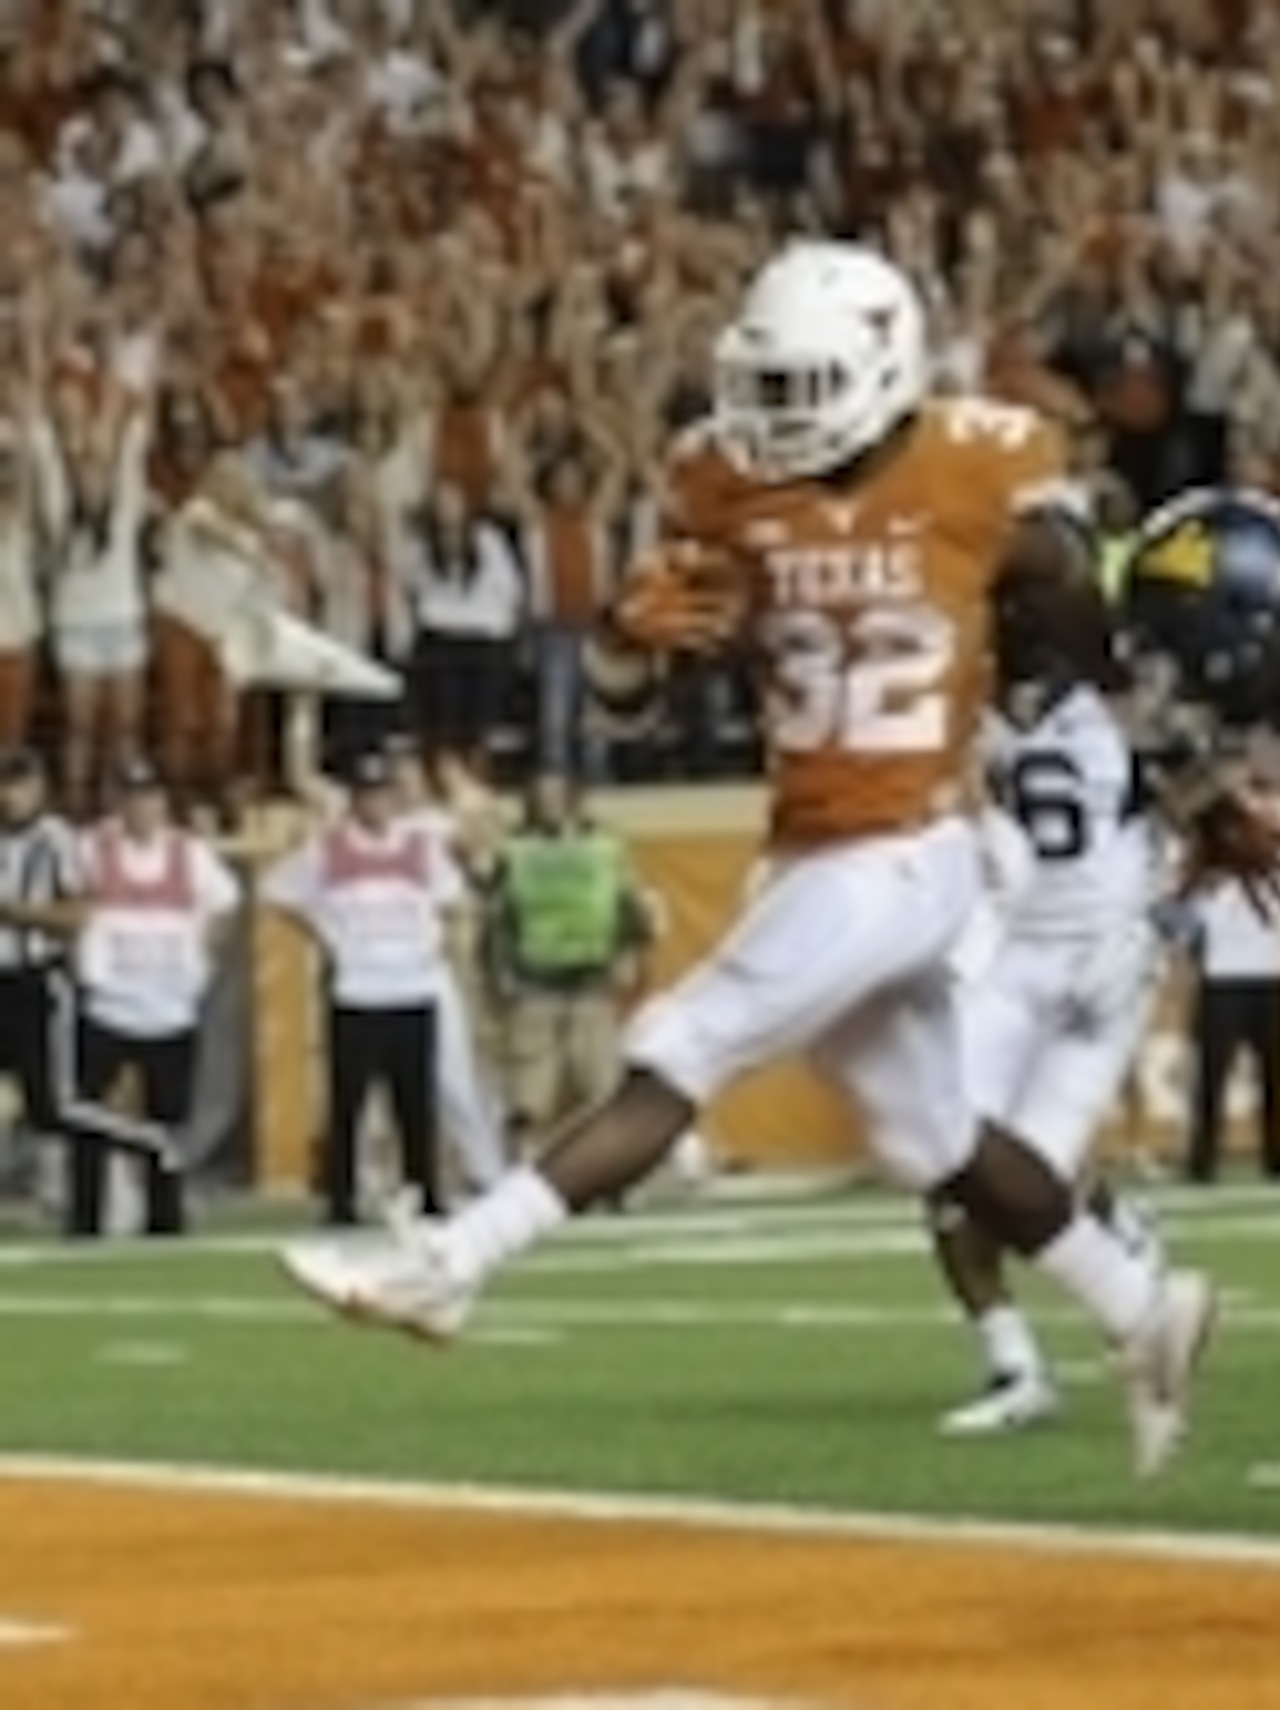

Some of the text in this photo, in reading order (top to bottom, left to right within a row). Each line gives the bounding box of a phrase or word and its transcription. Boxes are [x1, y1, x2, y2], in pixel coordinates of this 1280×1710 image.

[763, 545, 923, 603] TEXAS
[762, 607, 954, 750] 32
[1014, 750, 1086, 861] 6
